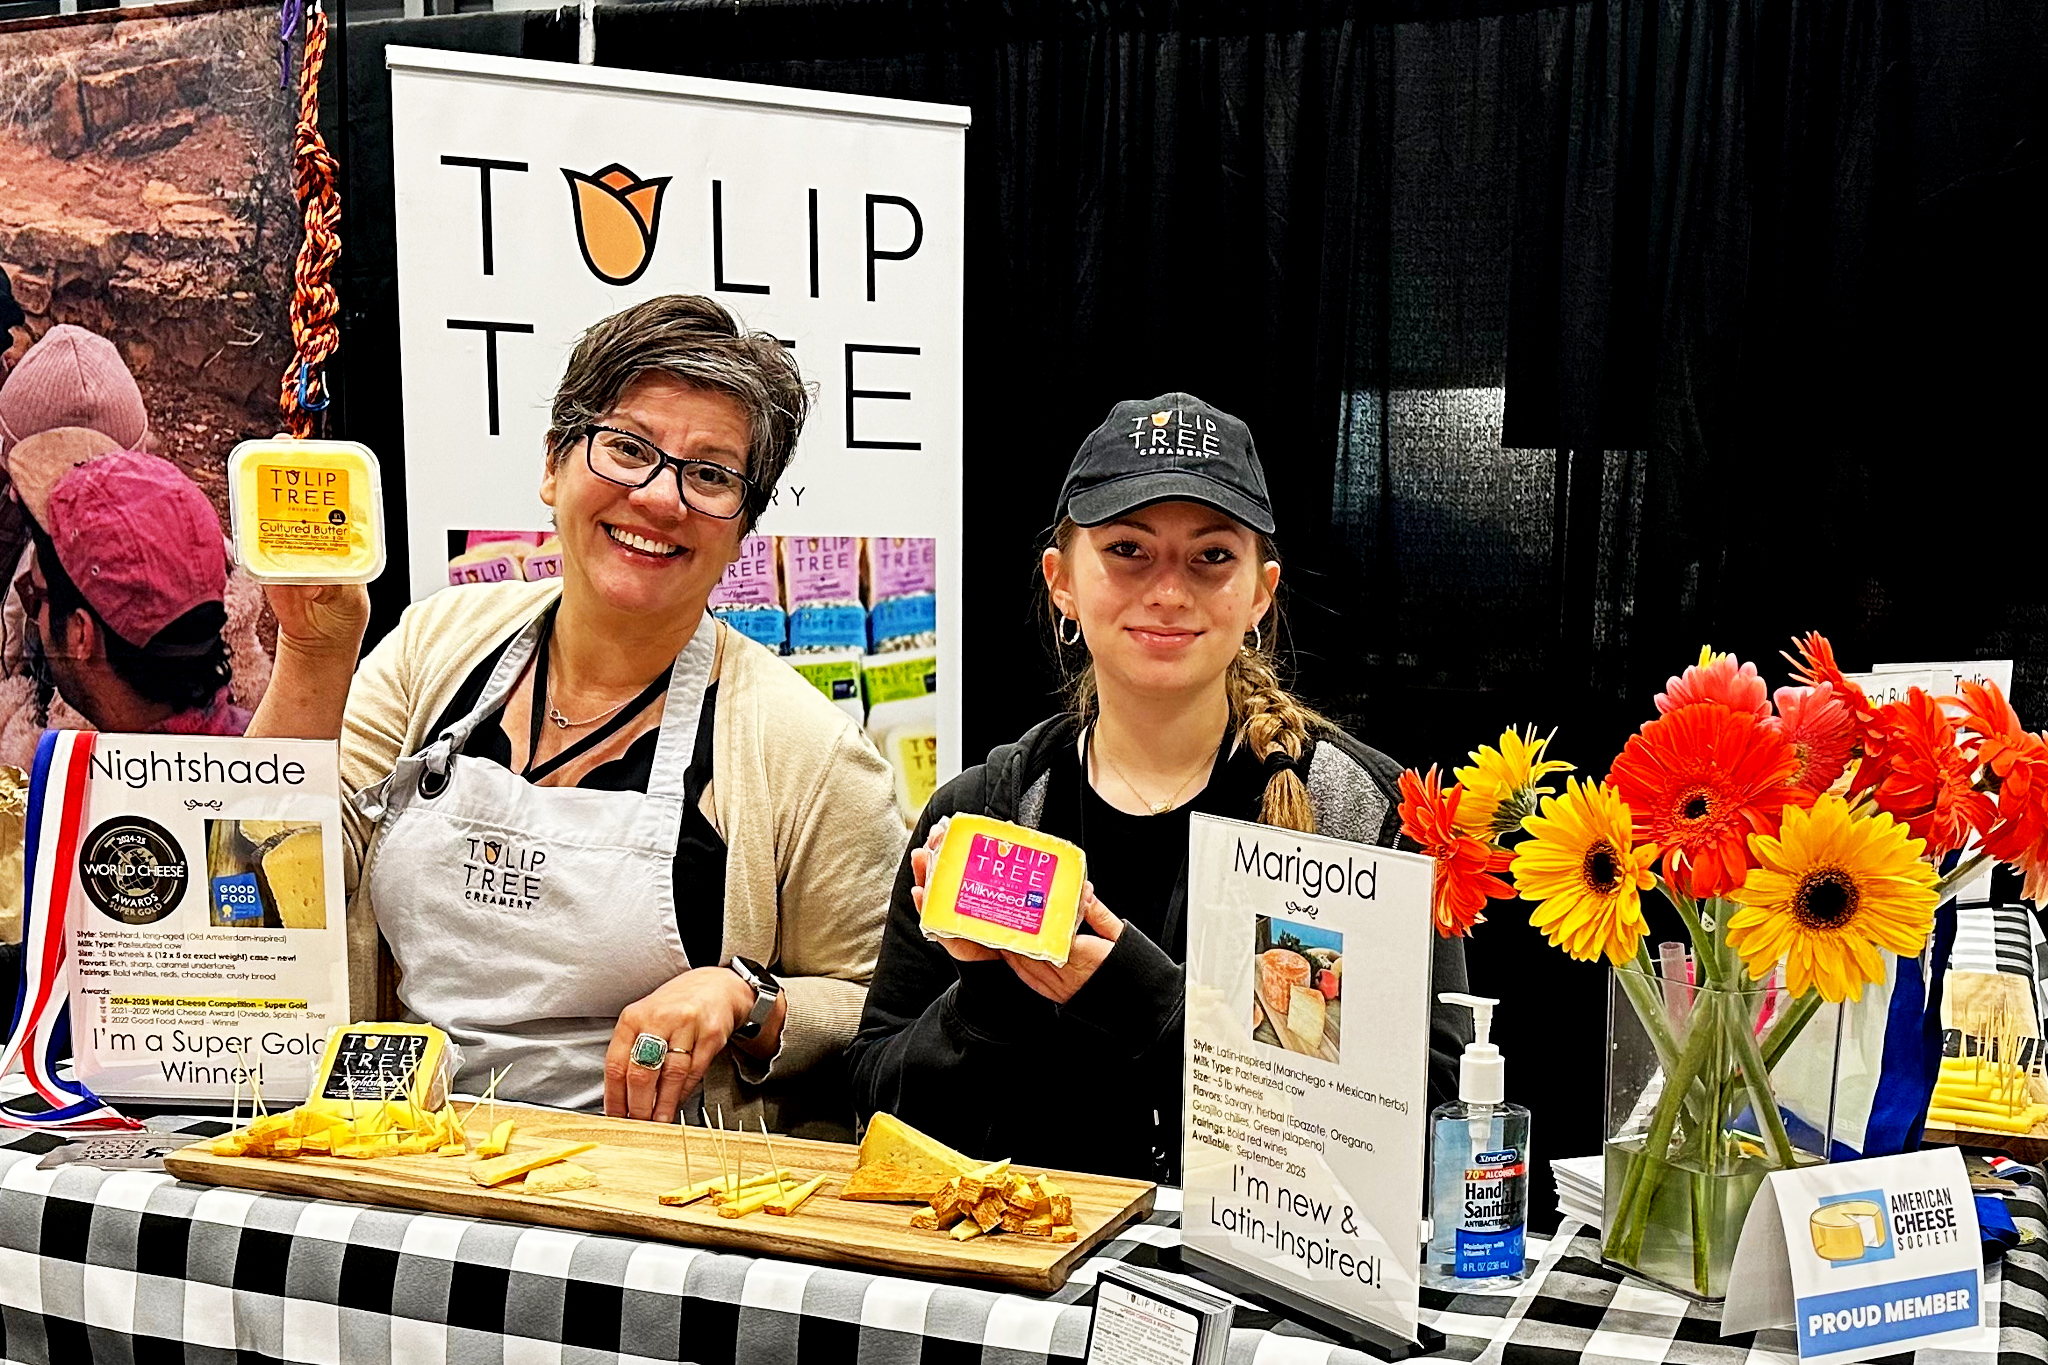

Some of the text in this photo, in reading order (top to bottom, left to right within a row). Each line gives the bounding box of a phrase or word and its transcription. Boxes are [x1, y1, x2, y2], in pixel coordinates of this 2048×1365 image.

[441, 155, 924, 302] TULIP
[447, 319, 922, 451] TE
[1132, 410, 1217, 434] TULIP
[1129, 428, 1220, 456] TREE
[1140, 447, 1210, 459] CREAMERY
[270, 469, 336, 487] TULIP
[270, 488, 336, 506] TREE
[260, 522, 310, 534] Cultured
[314, 525, 348, 536] Butter
[728, 560, 766, 578] REE
[795, 553, 849, 573] TREE
[89, 749, 305, 789] Nightshade
[116, 834, 146, 845] 2024-25
[467, 838, 546, 872] TULIP
[982, 835, 1051, 867] TULIP
[84, 864, 185, 878] WORLD CHEESE
[977, 854, 1046, 889] TREE
[1234, 837, 1377, 901] Marigold
[220, 884, 256, 894] GOOD
[464, 864, 541, 900] TREE
[112, 892, 159, 908] AWARDS
[221, 894, 256, 904] FOOD
[465, 890, 532, 910] CREAMERY
[961, 880, 1027, 908] Milkweed
[109, 901, 163, 917] SUPER GOLD
[156, 961, 189, 969] caramel
[218, 953, 248, 962] weight)
[113, 969, 130, 977] Bold
[226, 973, 249, 981] crusty
[251, 973, 277, 981] bread
[81, 987, 112, 995] Awards:
[152, 998, 175, 1006] World
[176, 999, 206, 1007] Cheese
[208, 1000, 256, 1009] Competition
[264, 1001, 287, 1010] Super
[289, 1001, 308, 1010] Gold
[152, 1008, 175, 1016] World
[176, 1008, 206, 1016] Cheese
[208, 1009, 235, 1017] Award
[306, 1011, 326, 1019] Silver
[111, 1016, 240, 1027] 2022 Good Food Award Winner
[145, 1033, 163, 1052] a
[172, 1030, 253, 1058] Super
[348, 1034, 423, 1051] TULIP
[342, 1052, 418, 1070] TREE
[161, 1060, 265, 1086] Winner!
[1193, 1054, 1306, 1097] Milk Type: Pasteurized cow
[1193, 1038, 1215, 1053] Style:
[1216, 1045, 1272, 1072] Latin-inspired
[1273, 1062, 1326, 1089] (Manchego
[1336, 1081, 1377, 1104] Mexican
[1378, 1093, 1409, 1115] herbs)
[1193, 1069, 1211, 1083] Size:
[1224, 1079, 1232, 1090] lb
[1234, 1083, 1264, 1101] wheels
[1193, 1084, 1223, 1103] Flavors:
[1256, 1104, 1285, 1123] herbal
[1286, 1114, 1328, 1138] (Epazote,
[1330, 1129, 1375, 1154] Oregano,
[1253, 1119, 1281, 1136] Green
[1192, 1114, 1288, 1157] Pairings: Bold red wines
[1192, 1129, 1306, 1179] Available: September 2025
[1466, 1169, 1516, 1180] 70% ALCOHOL
[1465, 1182, 1503, 1200] Hand
[1891, 1187, 1953, 1214] AMERICAN
[1278, 1187, 1332, 1225] new
[1341, 1205, 1359, 1238] &
[1464, 1201, 1521, 1219] Sanitizer
[1894, 1207, 1957, 1236] CHEESE
[1211, 1196, 1381, 1289] Latin-Inspired!
[1897, 1228, 1959, 1252] SOCIETY
[1462, 1262, 1468, 1272] 8
[1468, 1262, 1477, 1272] FL
[1477, 1262, 1486, 1272] OZ
[1152, 1302, 1176, 1320] TREE
[1808, 1289, 1970, 1337] PROUD MEMBER
